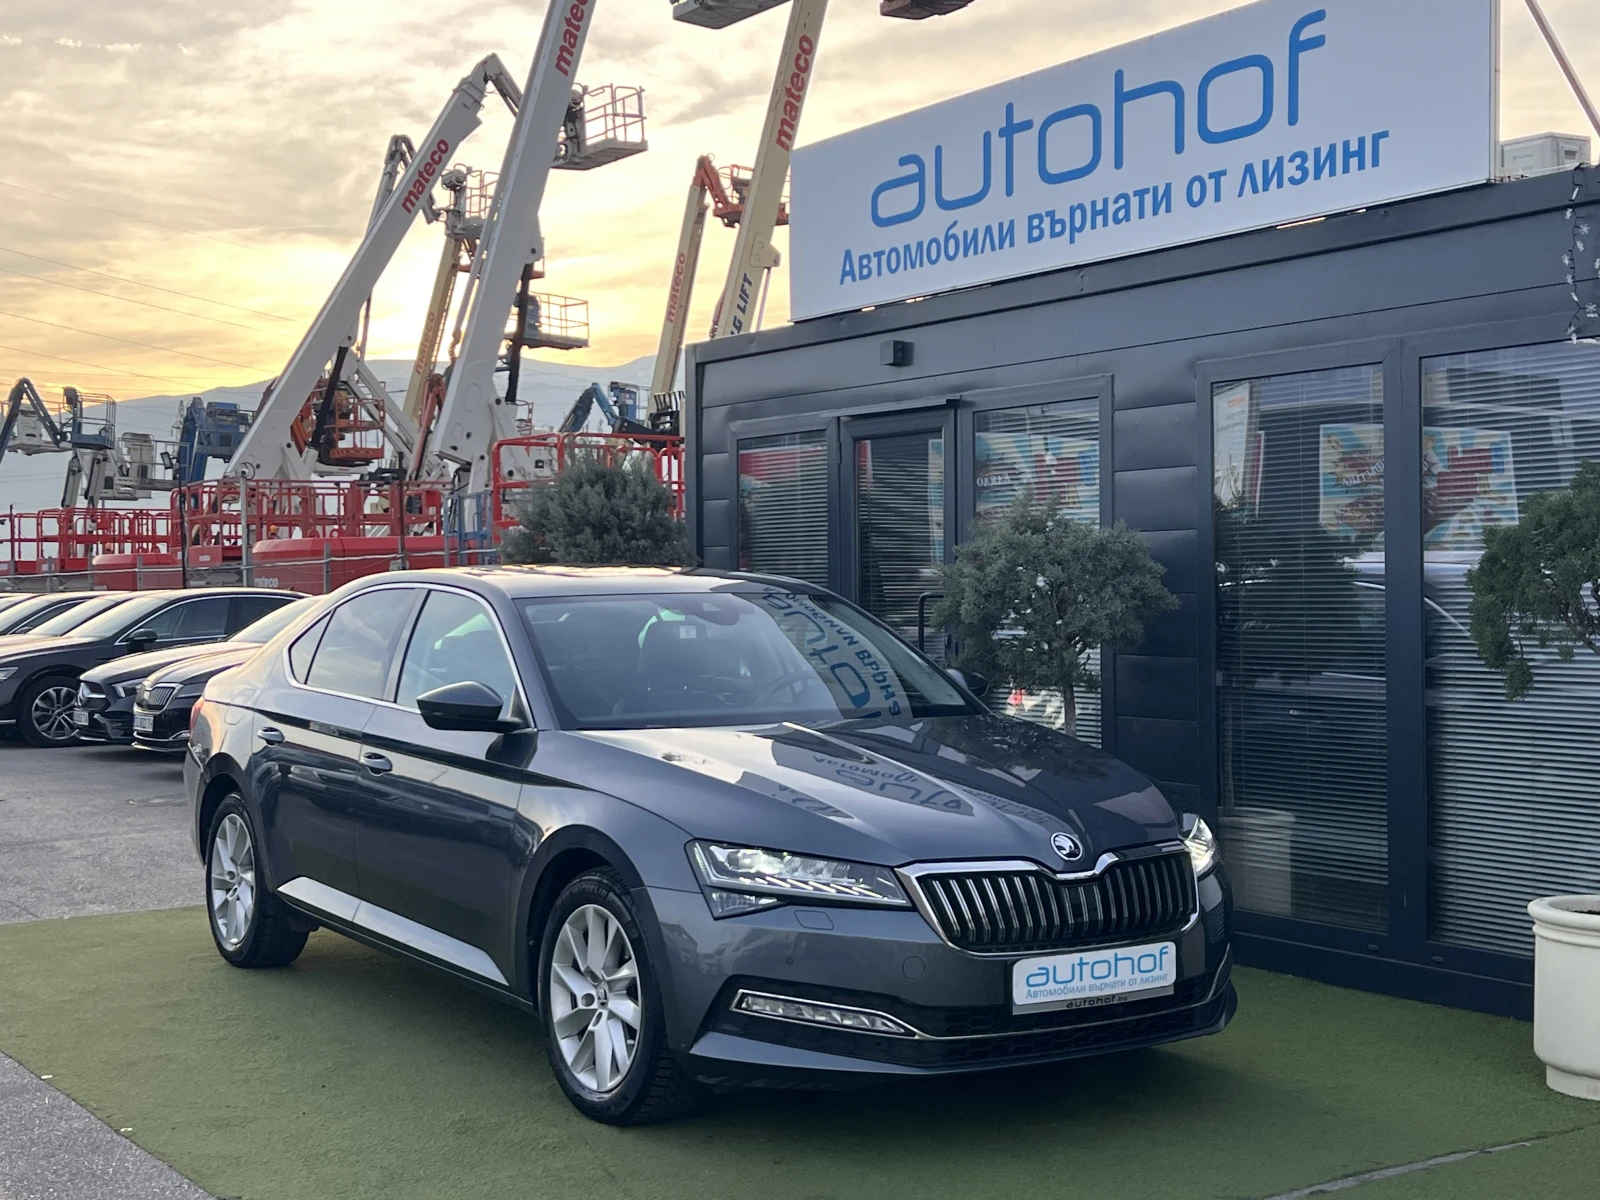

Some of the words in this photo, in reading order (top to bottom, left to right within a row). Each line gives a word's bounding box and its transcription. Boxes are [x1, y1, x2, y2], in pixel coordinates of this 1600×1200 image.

[776, 35, 814, 152] mateco
[871, 9, 1326, 228] autohof
[401, 139, 449, 214] mateco
[840, 220, 1015, 285] Автомобили
[1027, 182, 1172, 244] върнати
[1186, 169, 1227, 208] от
[1237, 130, 1389, 198] лизинг
[667, 252, 685, 324] mateco
[737, 272, 752, 315] LIFT
[1026, 945, 1169, 987] autohof
[1026, 984, 1086, 999] Автомобили
[1089, 979, 1126, 992] върнати
[1128, 977, 1138, 987] от
[1139, 973, 1169, 984] лизинг
